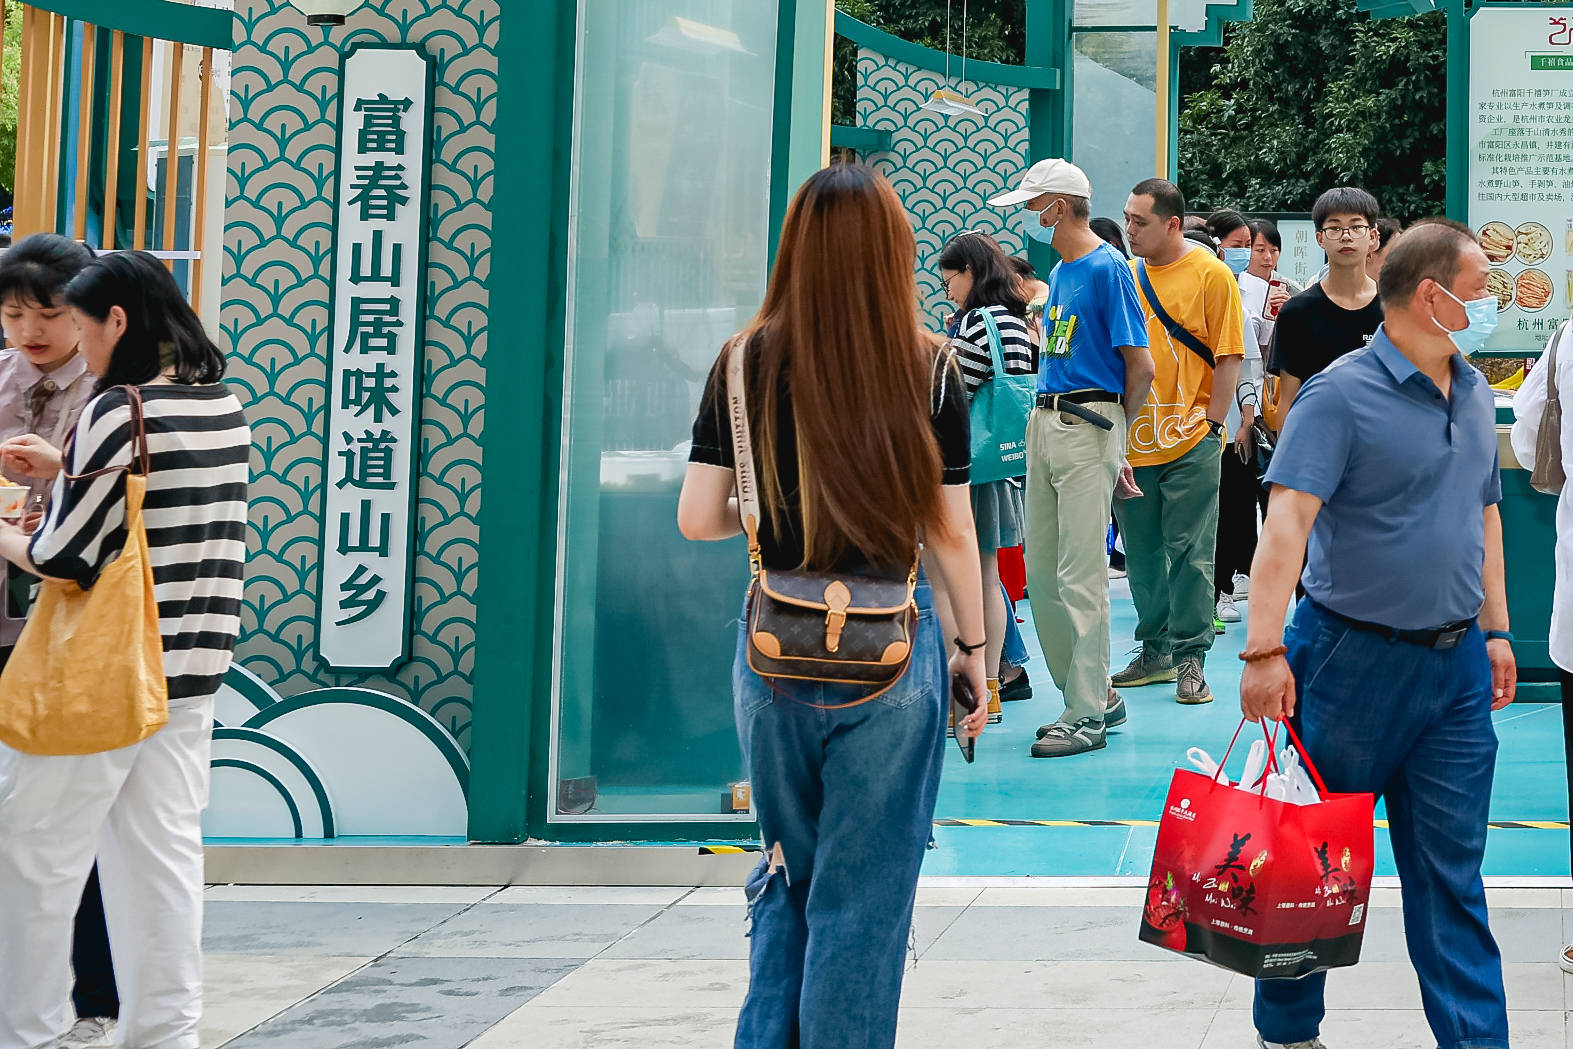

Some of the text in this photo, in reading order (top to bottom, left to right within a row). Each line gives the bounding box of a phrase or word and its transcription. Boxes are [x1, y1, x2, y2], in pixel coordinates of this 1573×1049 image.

[1516, 317, 1570, 331] 杭州富
[334, 92, 414, 628] 富春山居味道山乡
[1000, 442, 1017, 451] SINA
[1001, 452, 1024, 462] WEIBO
